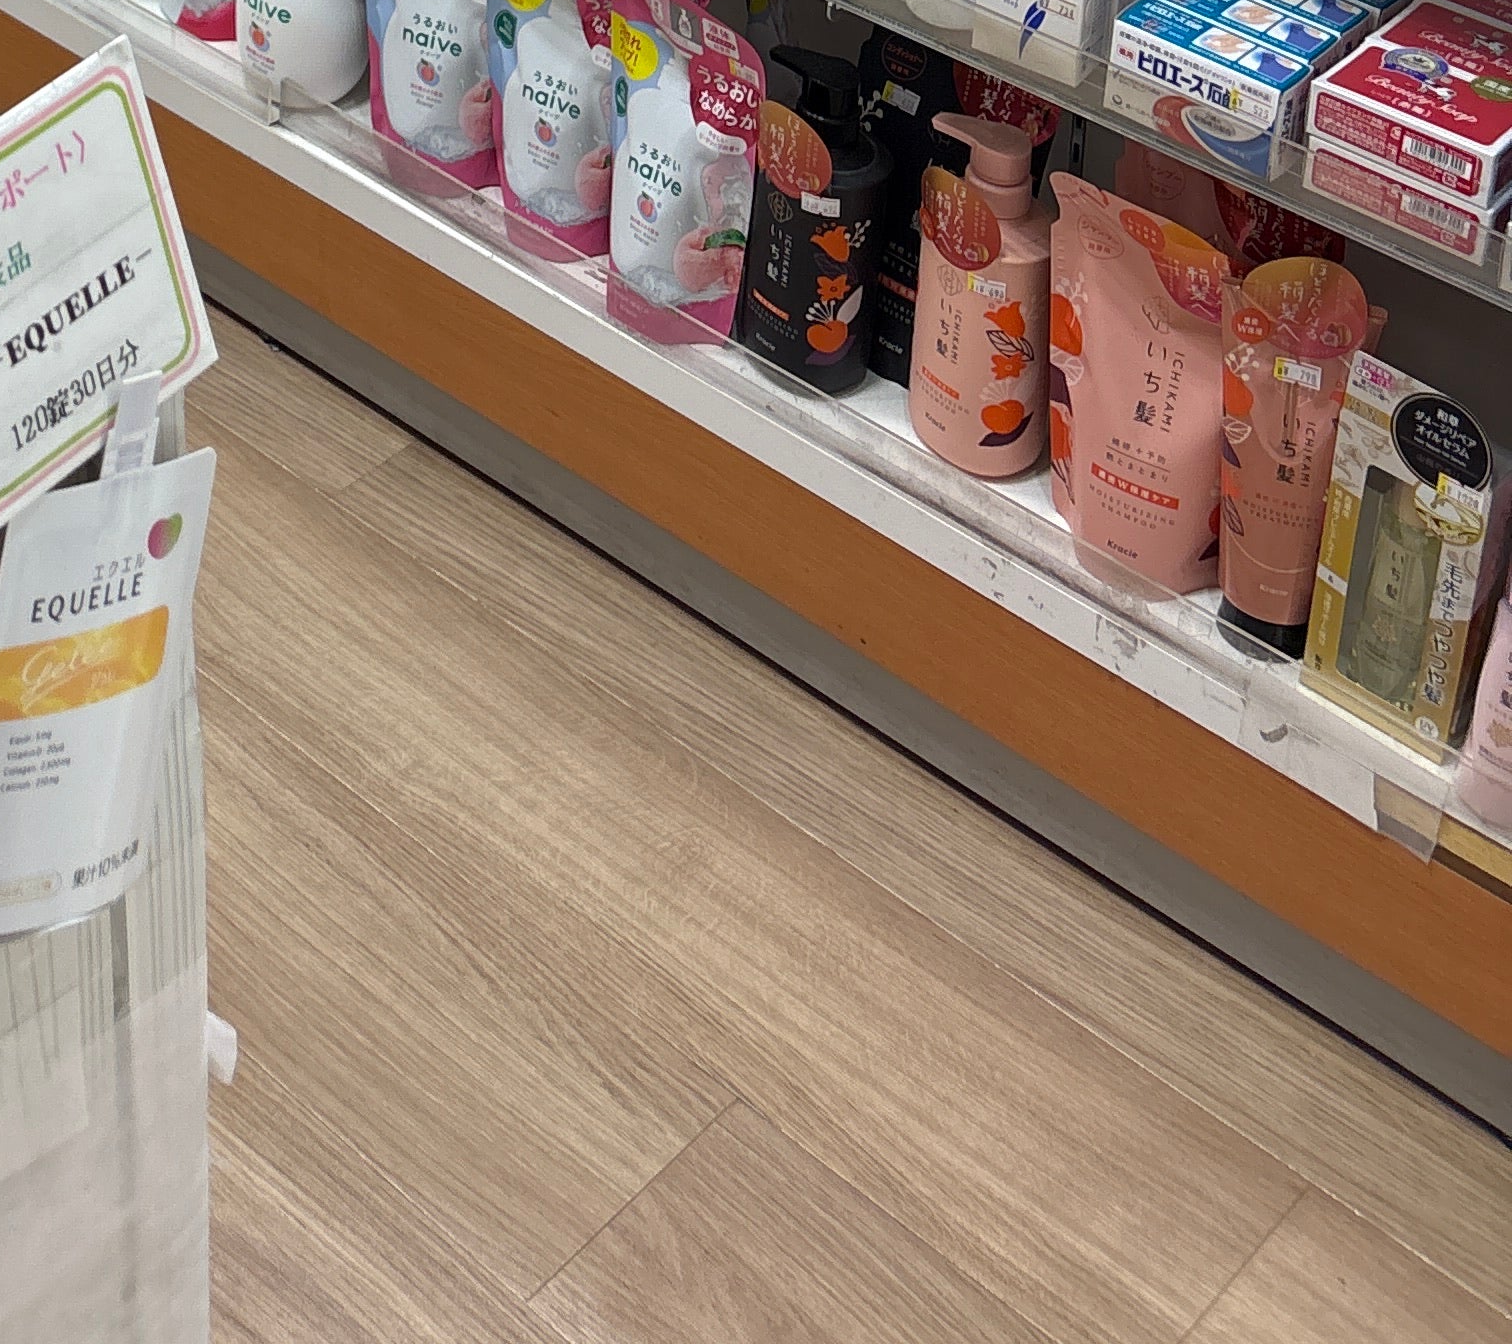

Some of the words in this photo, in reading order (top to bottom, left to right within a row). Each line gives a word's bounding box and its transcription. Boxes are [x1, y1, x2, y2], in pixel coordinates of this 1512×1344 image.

[401, 27, 464, 58] naive
[521, 83, 583, 122] naive
[626, 153, 684, 198] naive
[30, 573, 145, 624] EQUELLE
